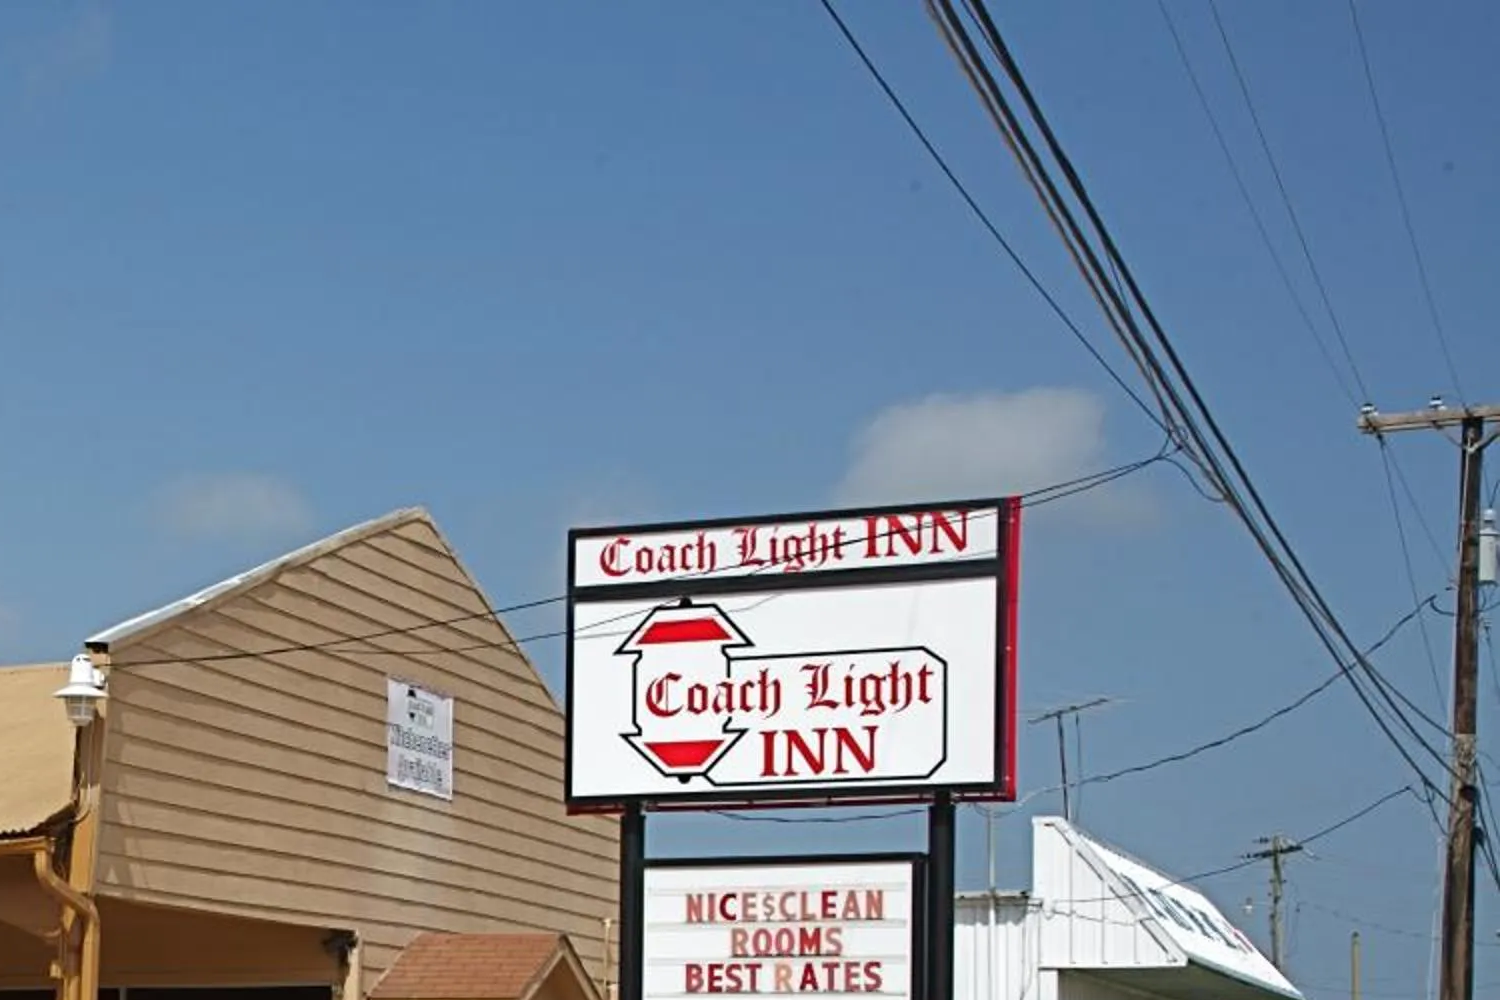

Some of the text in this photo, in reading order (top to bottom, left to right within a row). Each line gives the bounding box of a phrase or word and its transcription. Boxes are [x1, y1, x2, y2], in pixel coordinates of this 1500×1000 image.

[599, 510, 969, 578] Coach Light INN
[645, 660, 936, 719] Coach Light
[758, 726, 879, 777] INN
[731, 927, 843, 958] ROOMS
[685, 961, 884, 993] BEST RATES
